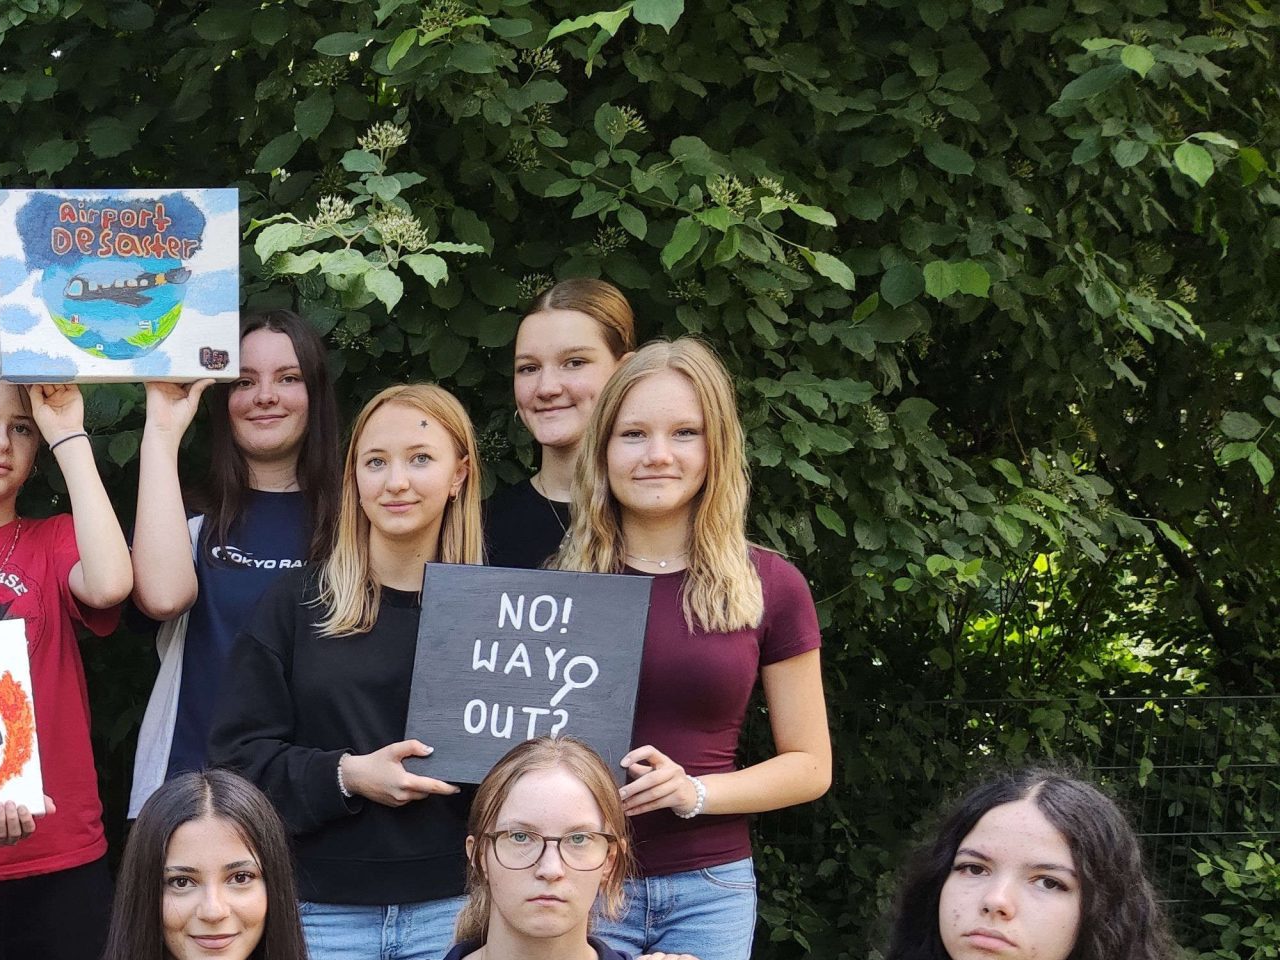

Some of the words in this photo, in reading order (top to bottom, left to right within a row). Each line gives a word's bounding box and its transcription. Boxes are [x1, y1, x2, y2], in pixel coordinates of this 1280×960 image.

[59, 202, 171, 231] Airport
[279, 560, 308, 568] RA
[498, 592, 573, 634] NO!
[472, 639, 566, 681] WAY
[463, 699, 569, 740] OUT?
